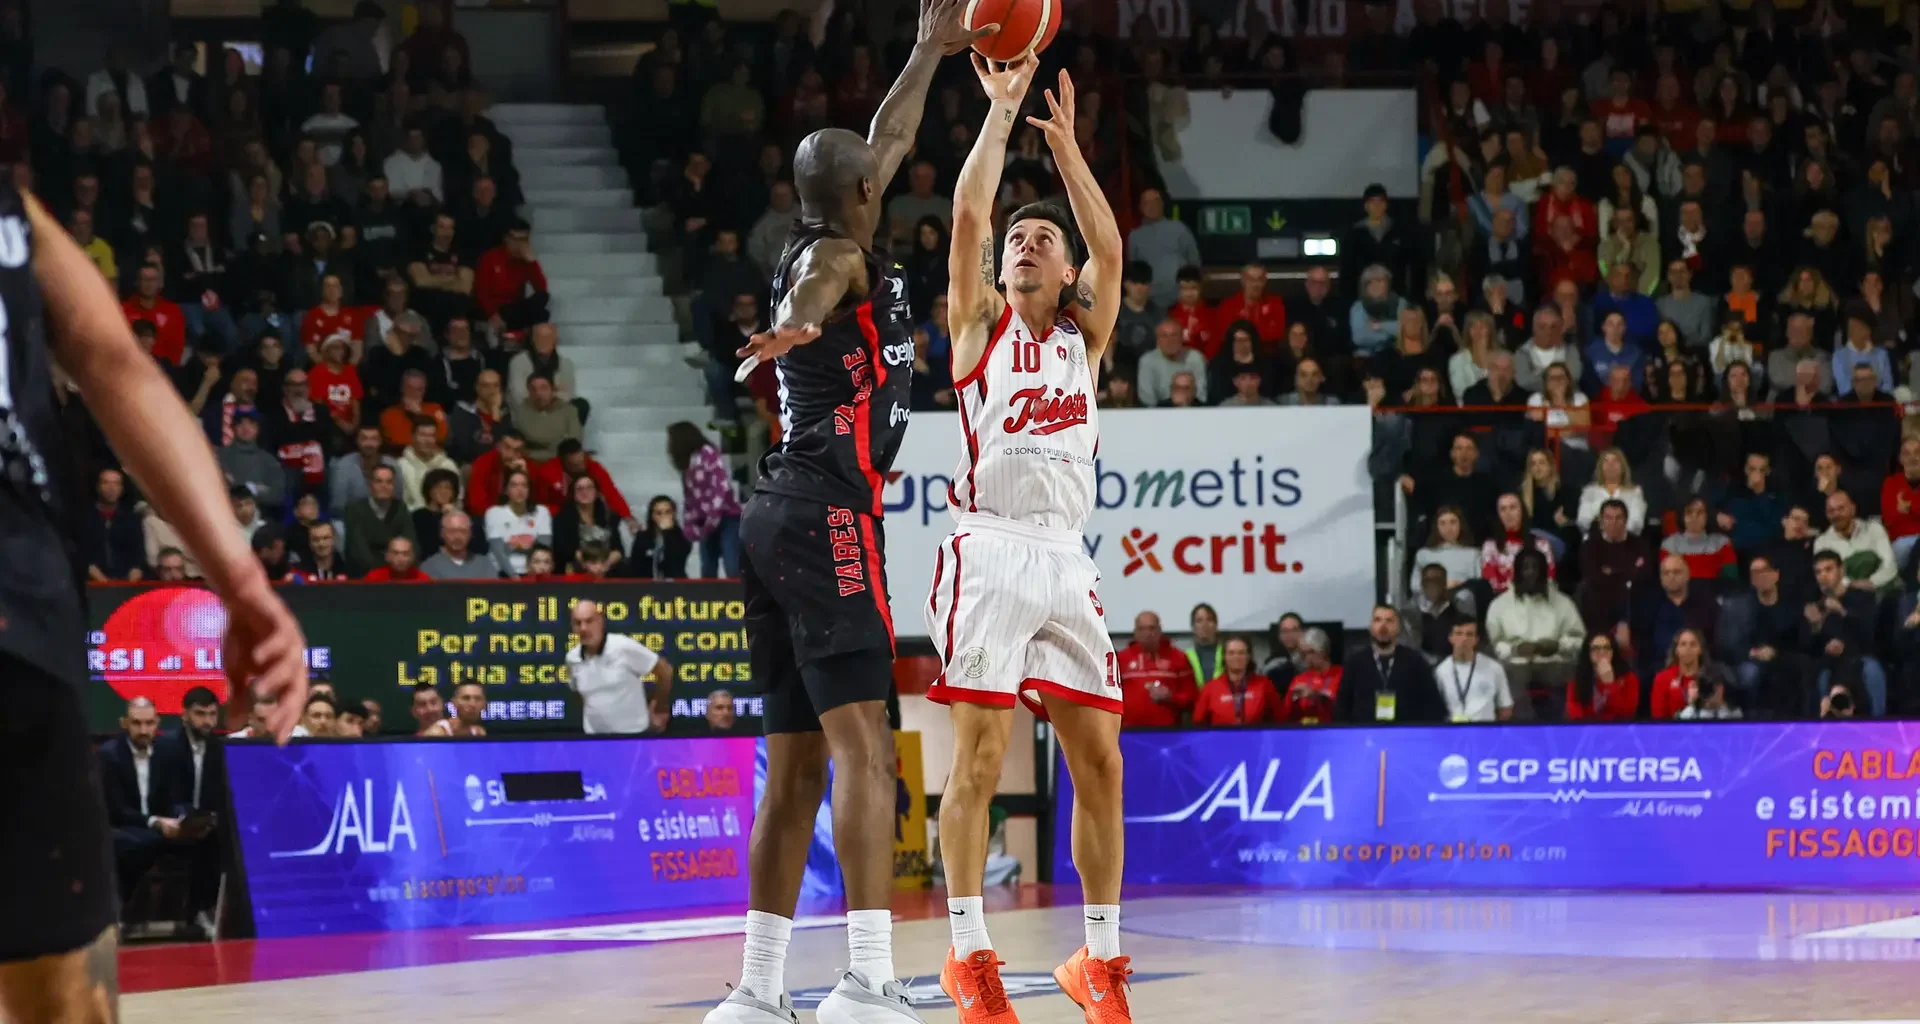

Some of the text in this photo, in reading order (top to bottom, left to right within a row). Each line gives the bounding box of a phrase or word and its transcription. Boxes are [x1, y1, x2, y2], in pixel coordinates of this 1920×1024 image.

[1011, 341, 1041, 373] 10
[1003, 448, 1012, 456] IO
[1014, 447, 1041, 456] SONO
[827, 505, 866, 597] VARES
[1172, 520, 1304, 575] crit.
[466, 597, 528, 623] Per
[538, 596, 559, 622] il
[639, 595, 746, 621] futuro
[417, 629, 480, 655] Per
[489, 632, 556, 653] non
[397, 661, 439, 686] La
[1478, 756, 1703, 784] SCP SINTERSA
[1200, 758, 1335, 821] ALA
[335, 778, 417, 853] ALA
[1755, 795, 1776, 821] e
[637, 817, 651, 842] e
